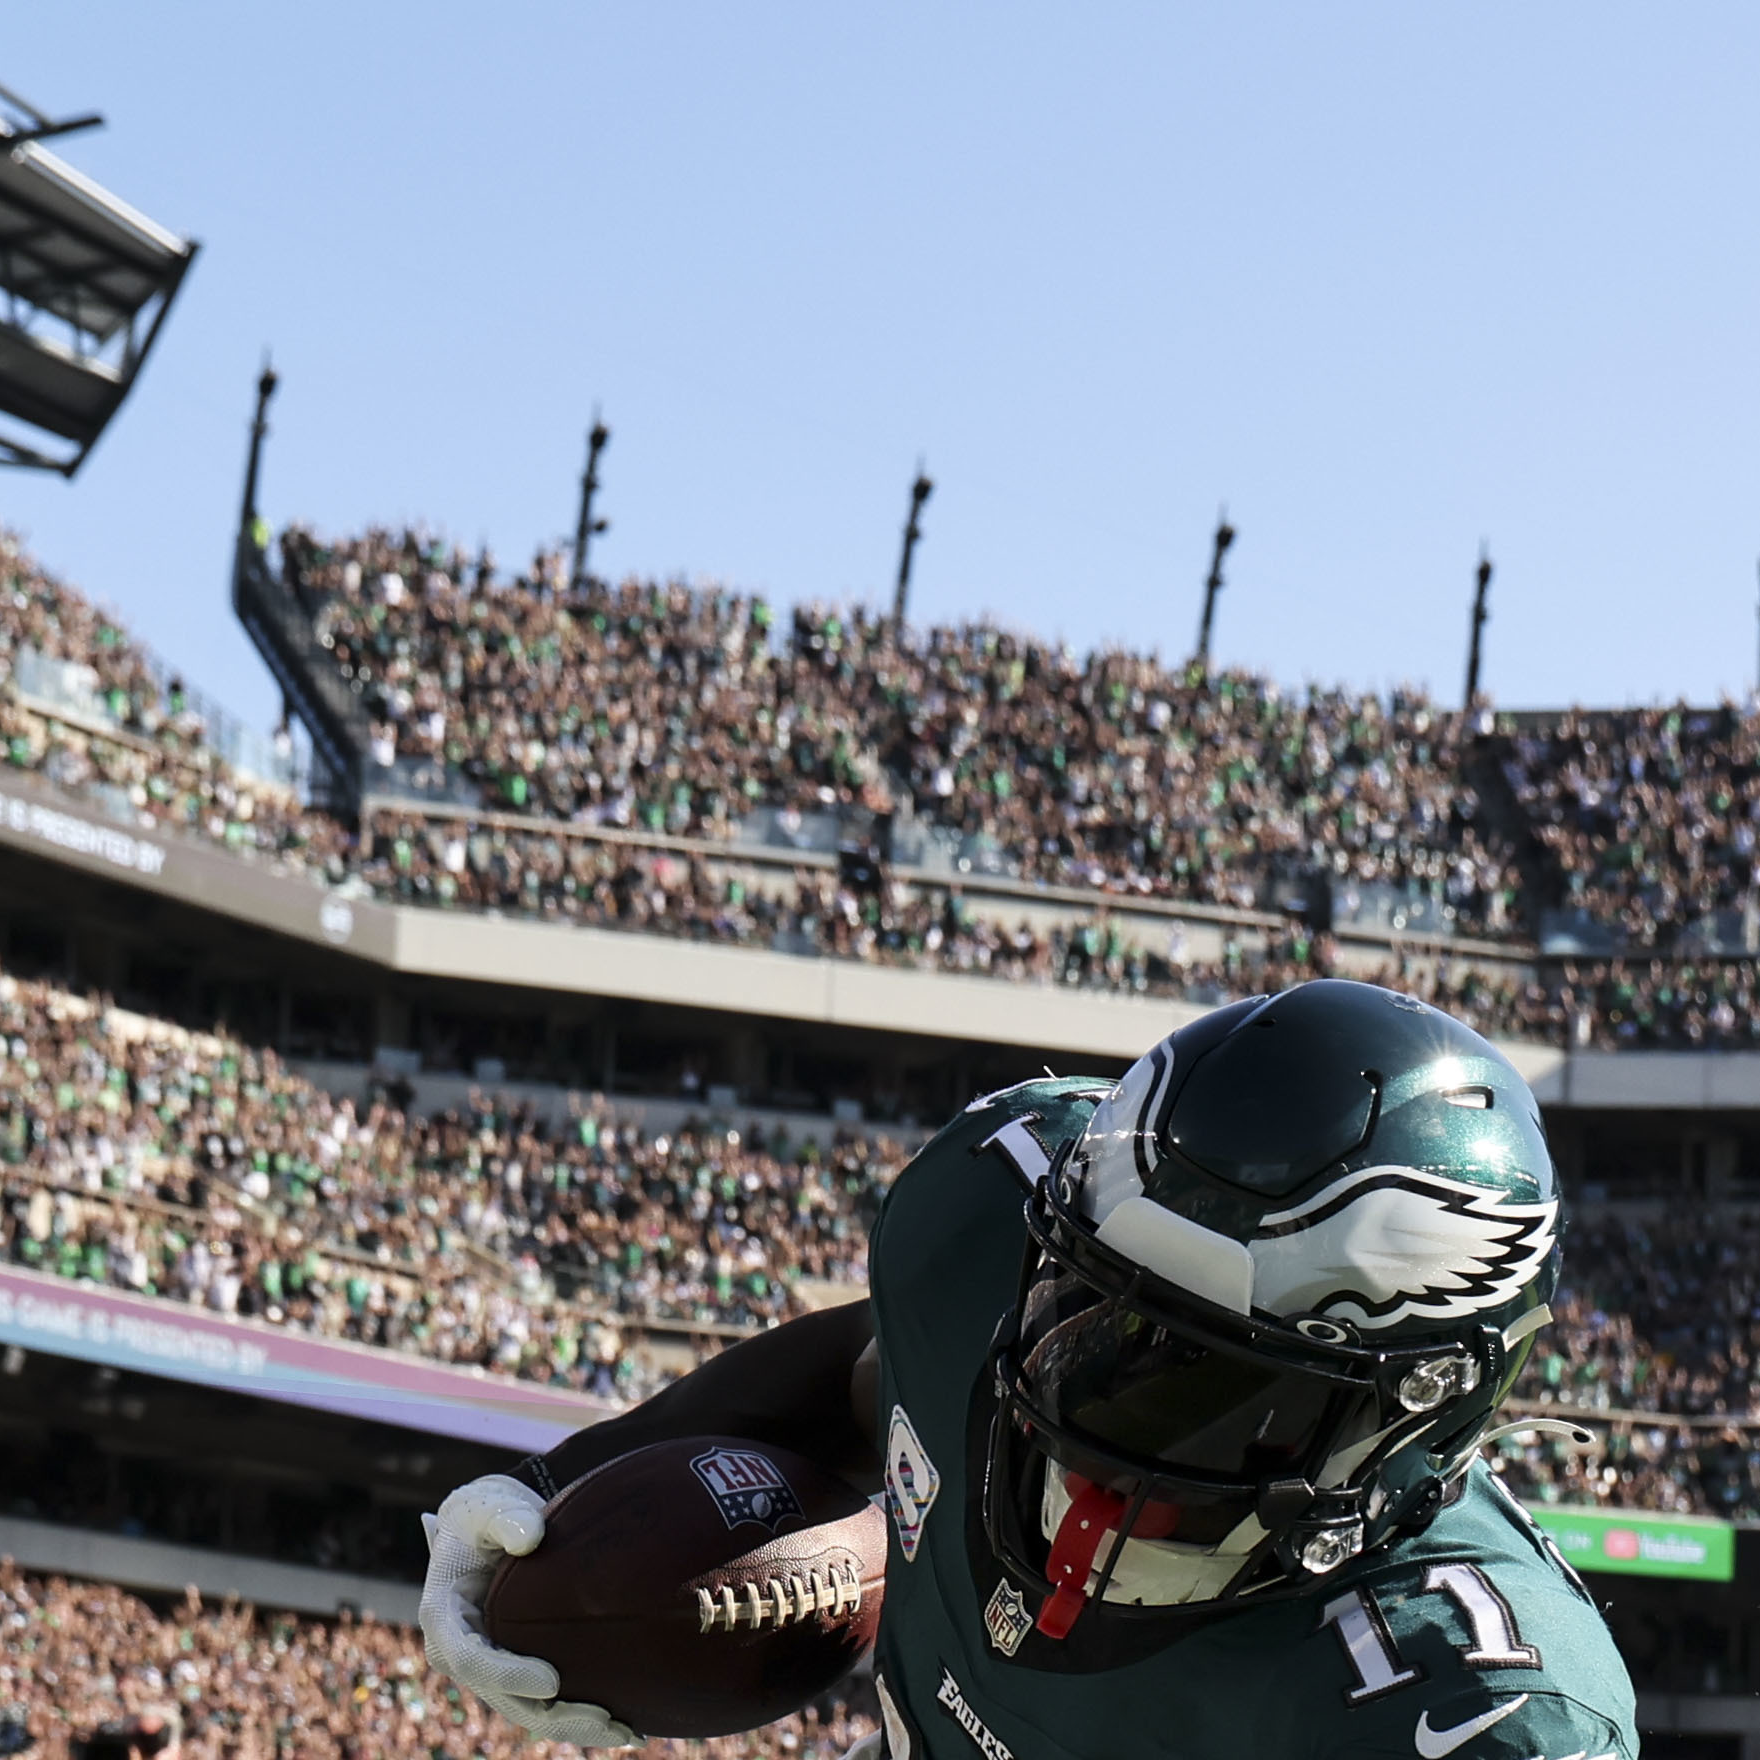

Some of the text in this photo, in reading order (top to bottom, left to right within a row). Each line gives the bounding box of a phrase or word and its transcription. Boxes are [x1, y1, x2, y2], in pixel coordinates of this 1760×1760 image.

[700, 1453, 782, 1492] NFL
[989, 1609, 1015, 1649] NFL
[1315, 1563, 1539, 1702] 11
